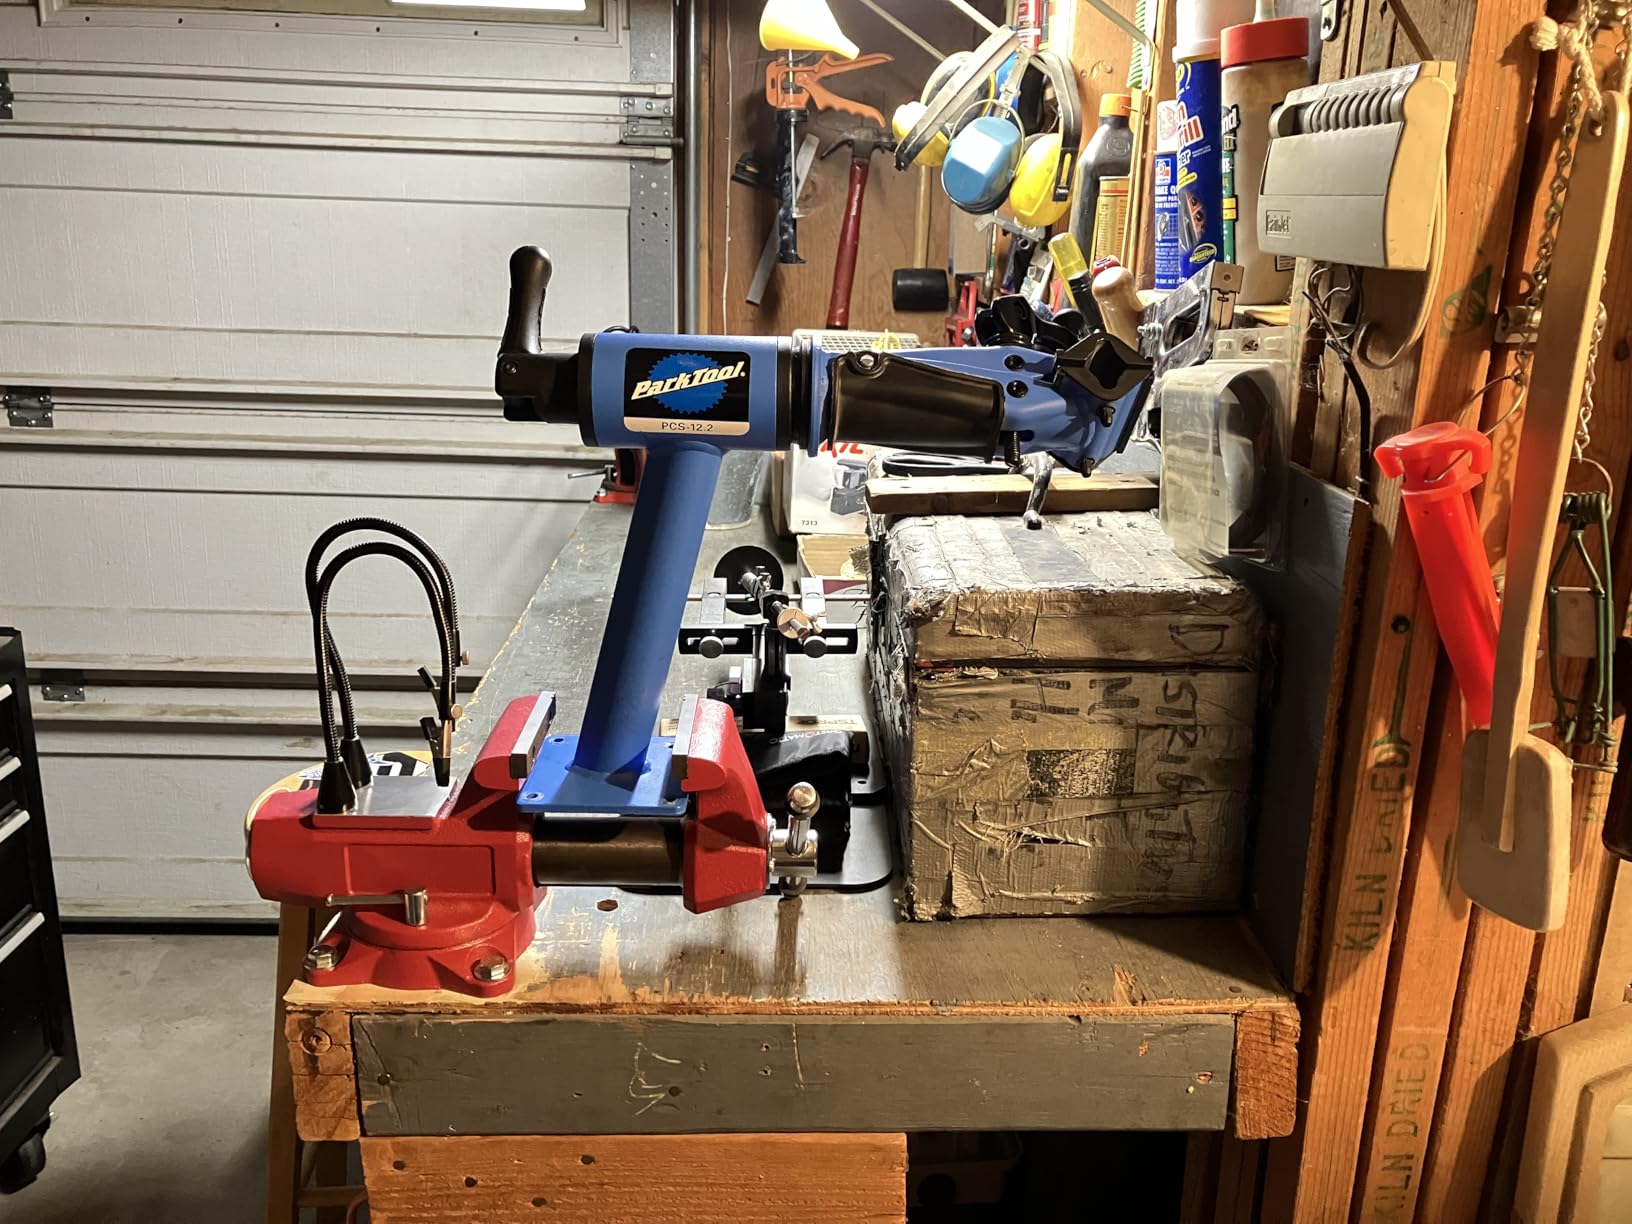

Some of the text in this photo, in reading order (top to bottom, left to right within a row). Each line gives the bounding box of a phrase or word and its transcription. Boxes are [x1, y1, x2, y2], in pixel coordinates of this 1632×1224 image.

[1178, 118, 1201, 146] rill
[661, 421, 714, 431] PCS-12.2
[1342, 873, 1387, 953] KILN
[1388, 1042, 1430, 1138] DRIED
